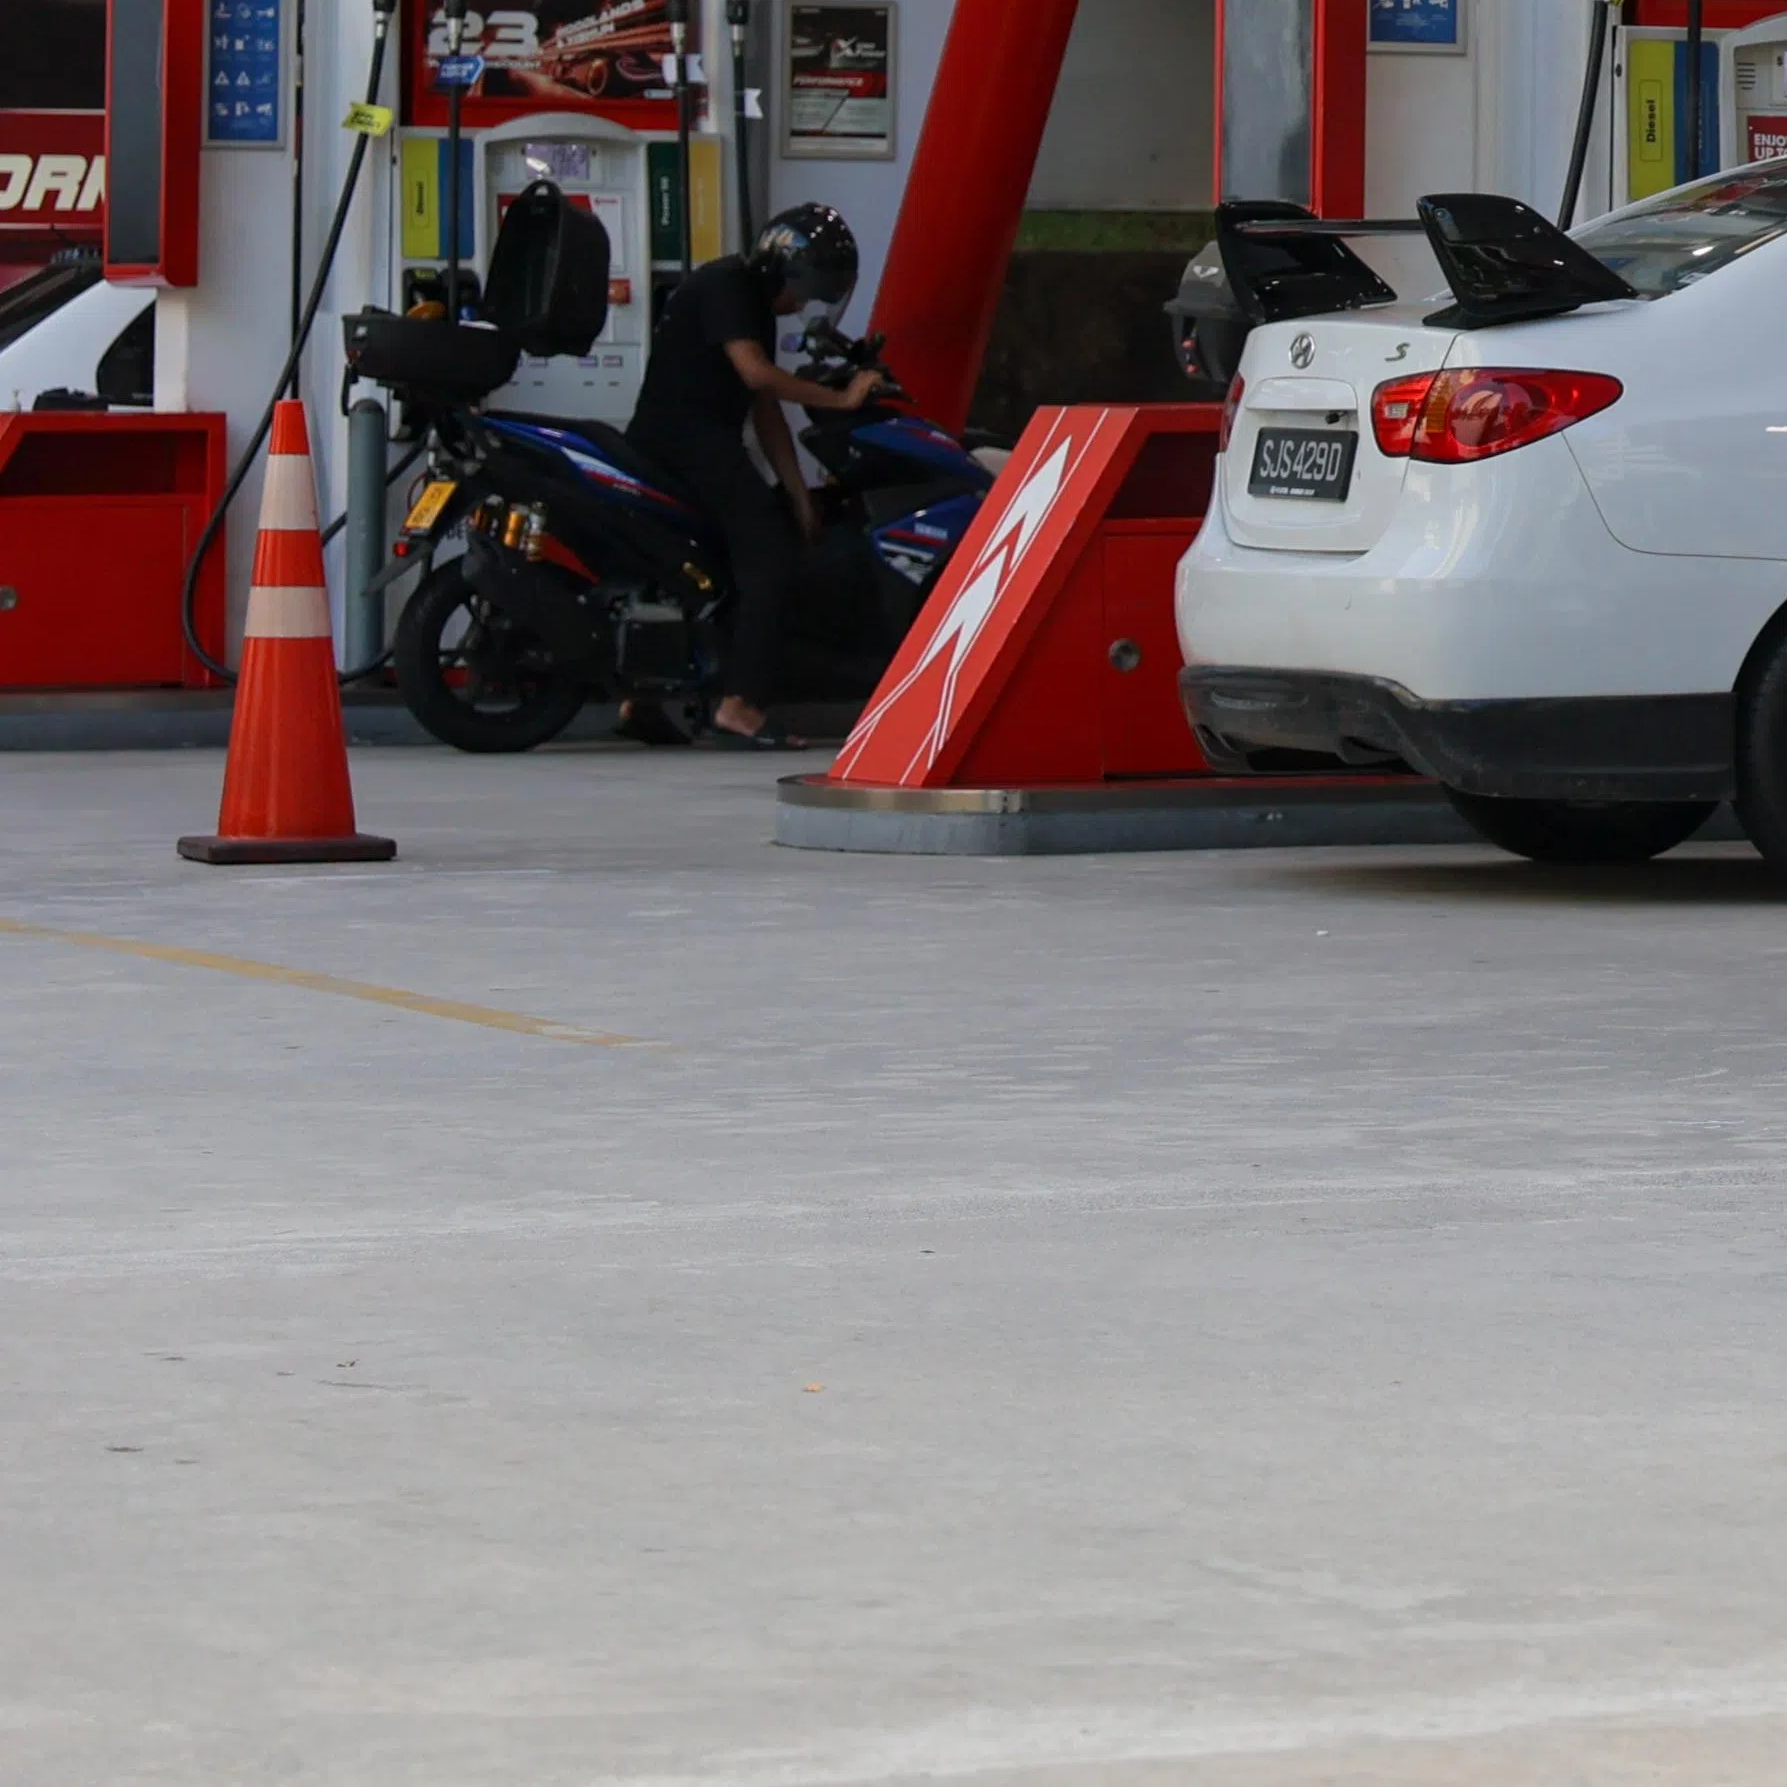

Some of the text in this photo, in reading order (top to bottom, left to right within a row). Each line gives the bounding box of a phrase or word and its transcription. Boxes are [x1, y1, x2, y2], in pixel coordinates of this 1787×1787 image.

[1646, 100, 1656, 143] Diesel
[1754, 148, 1774, 160] UP
[1260, 439, 1342, 481] SJS429D
